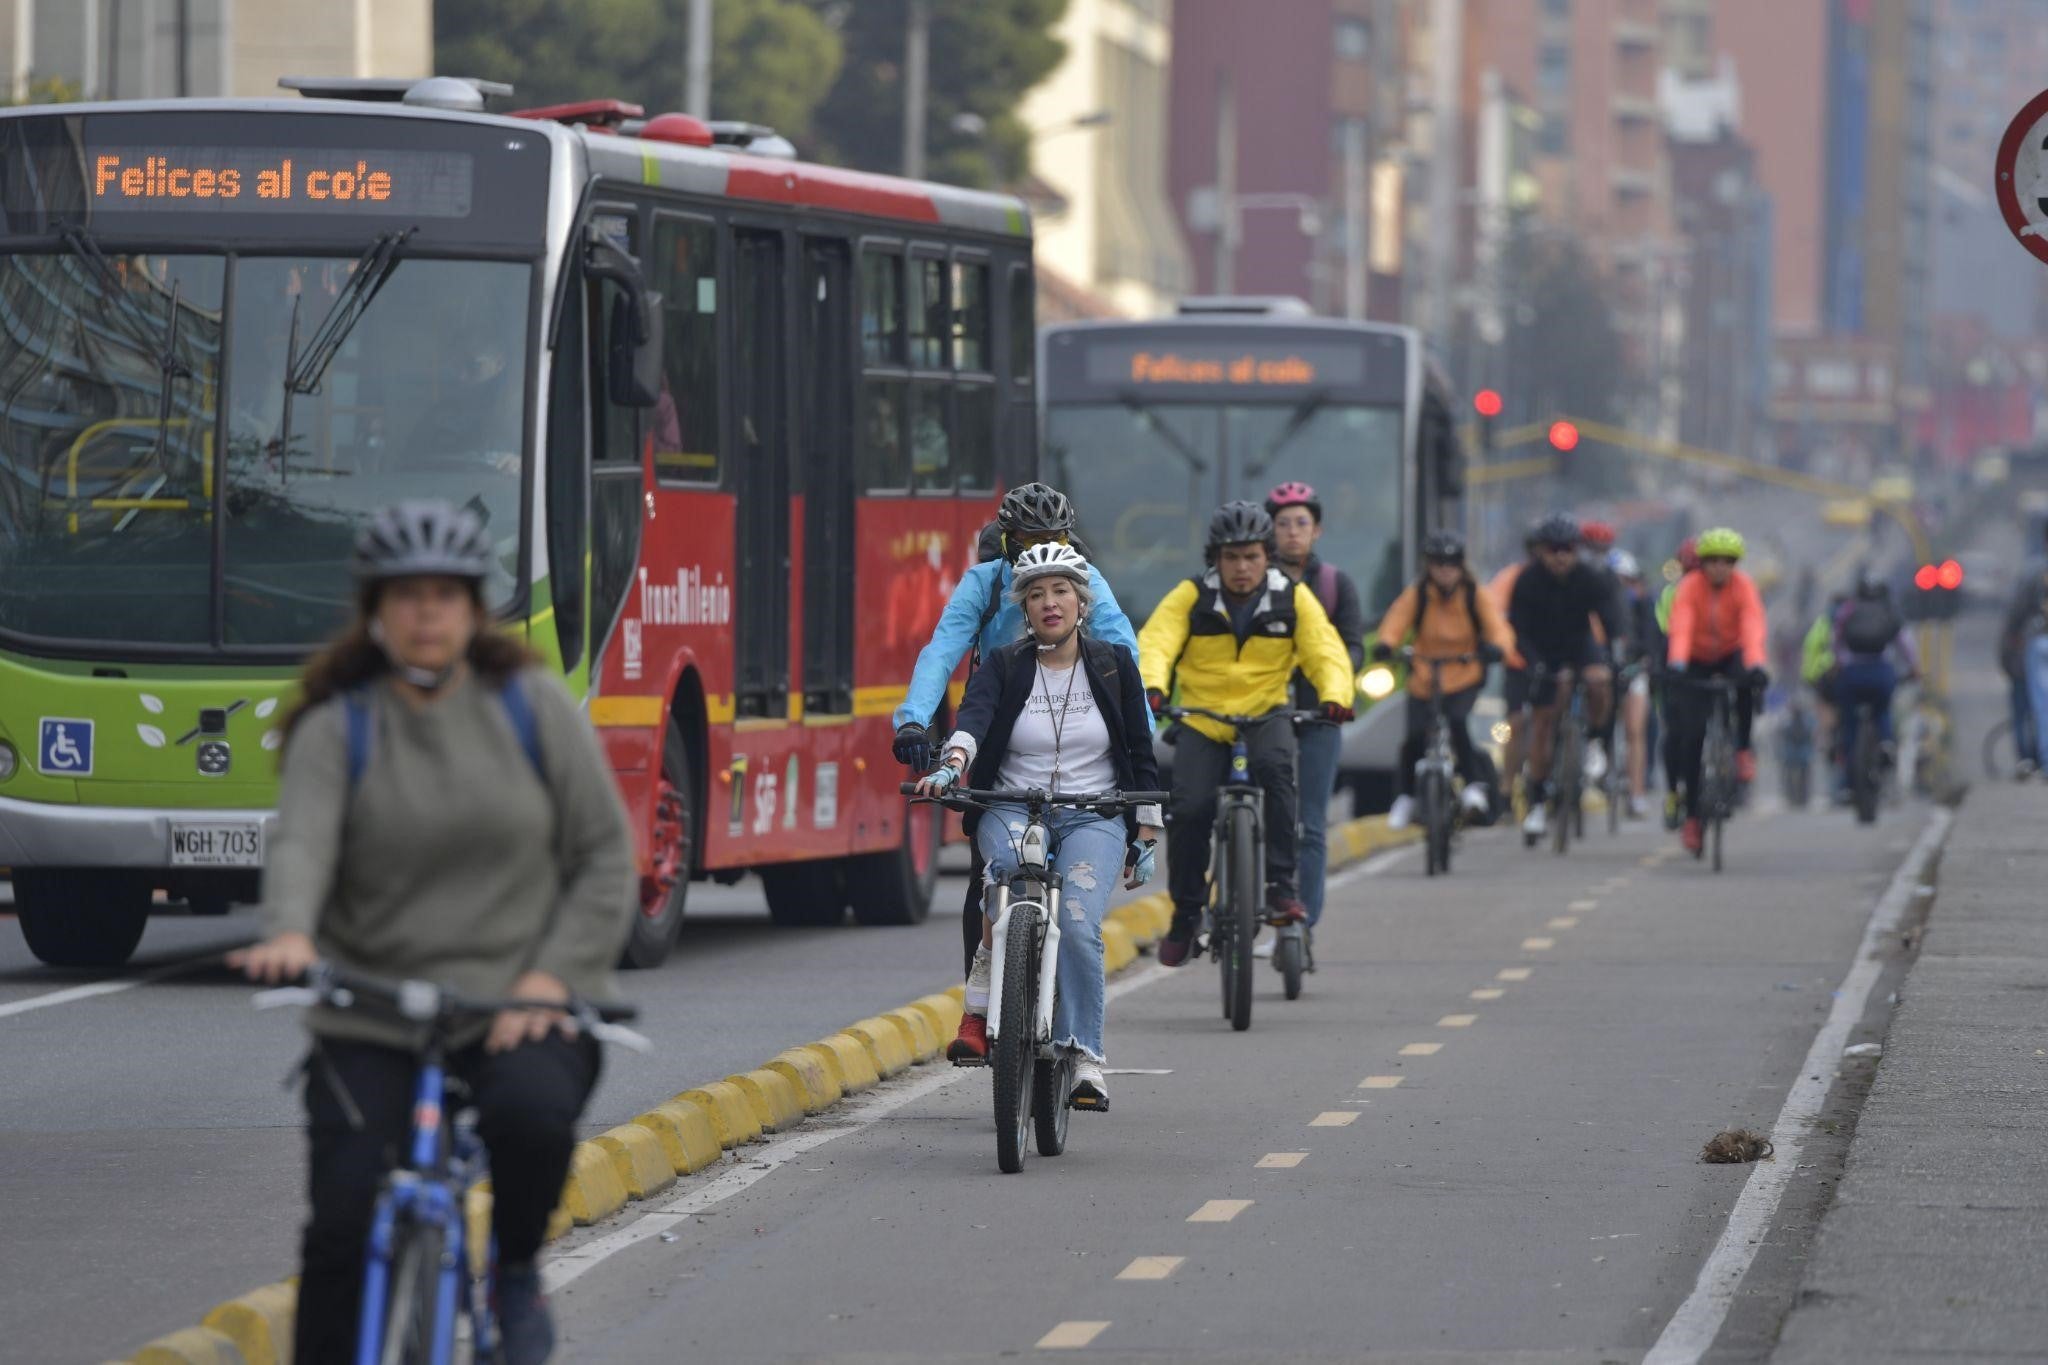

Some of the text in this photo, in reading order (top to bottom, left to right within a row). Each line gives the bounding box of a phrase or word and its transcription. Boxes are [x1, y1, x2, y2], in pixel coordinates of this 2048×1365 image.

[96, 156, 241, 198] Felices
[257, 159, 292, 199] al
[1132, 352, 1314, 385] Felices al cole
[639, 565, 730, 625] TransMilenio
[1030, 690, 1092, 704] MINDSET IS
